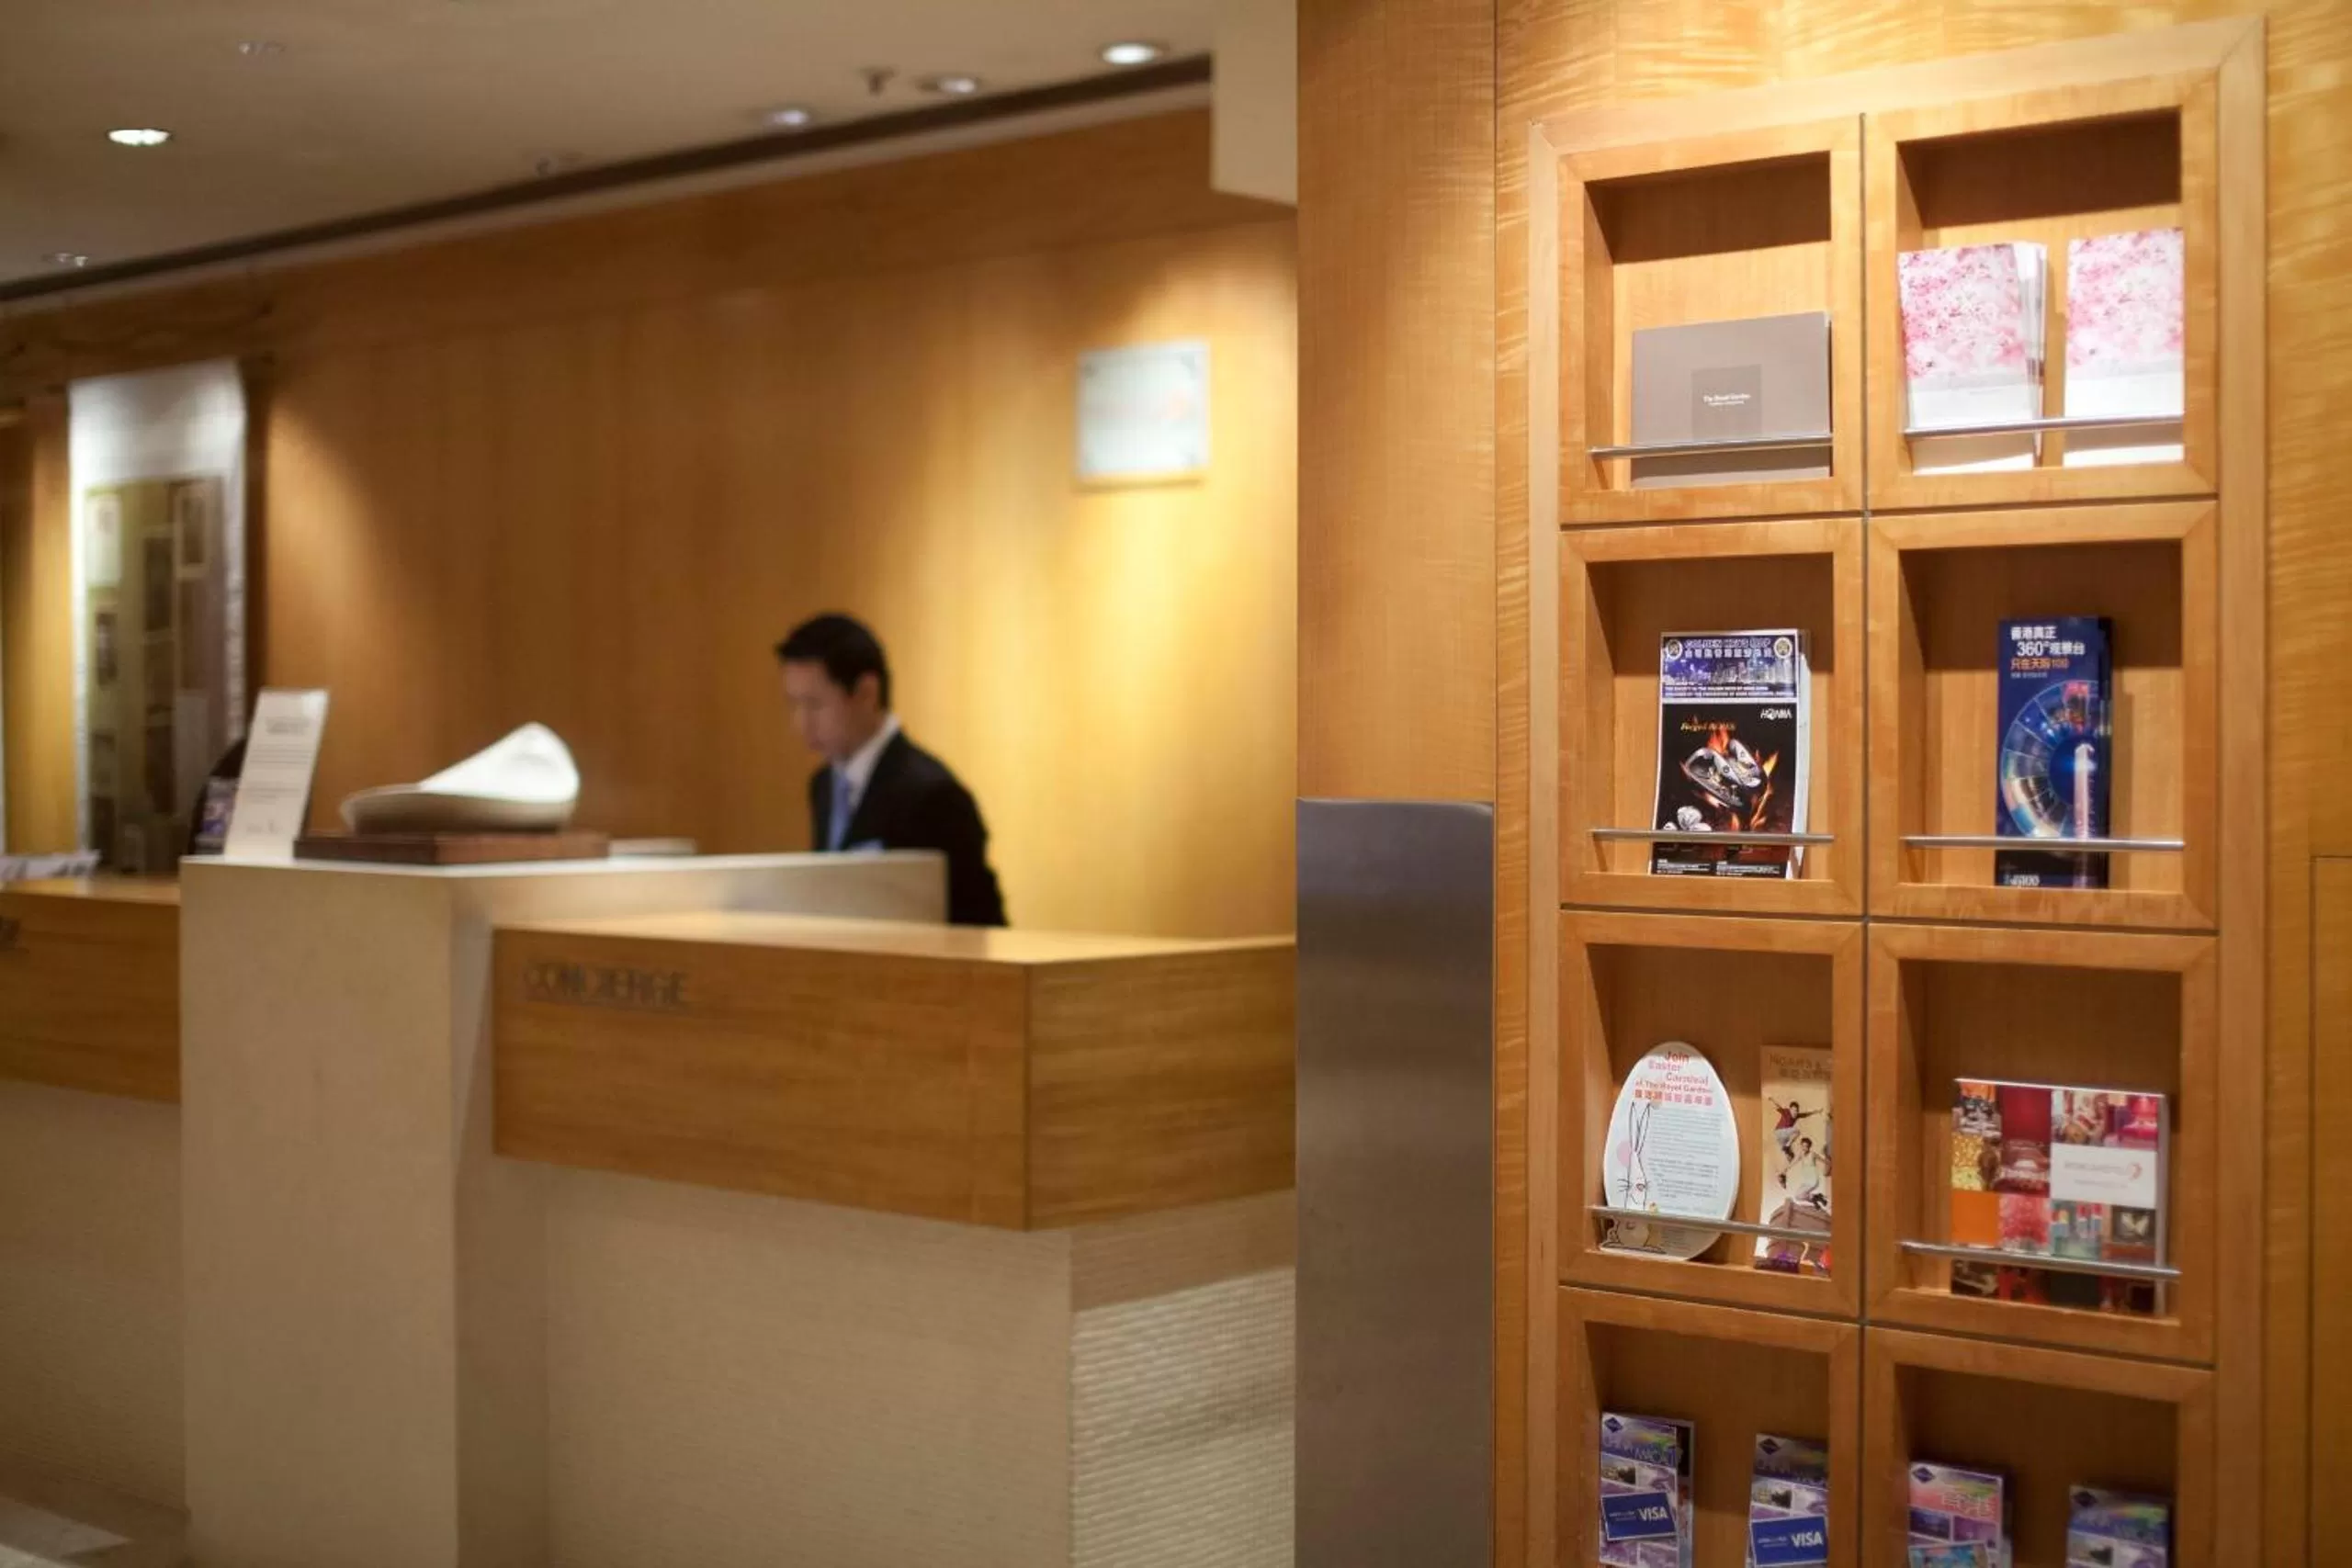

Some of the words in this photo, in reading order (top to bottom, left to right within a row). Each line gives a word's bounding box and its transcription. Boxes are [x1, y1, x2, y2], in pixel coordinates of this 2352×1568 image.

[522, 962, 690, 1012] CONCIERGE
[1665, 1051, 1690, 1062] Join
[1648, 1059, 1680, 1071] Easter
[1638, 1506, 1668, 1522] VISA
[1792, 1530, 1824, 1548] VISA
